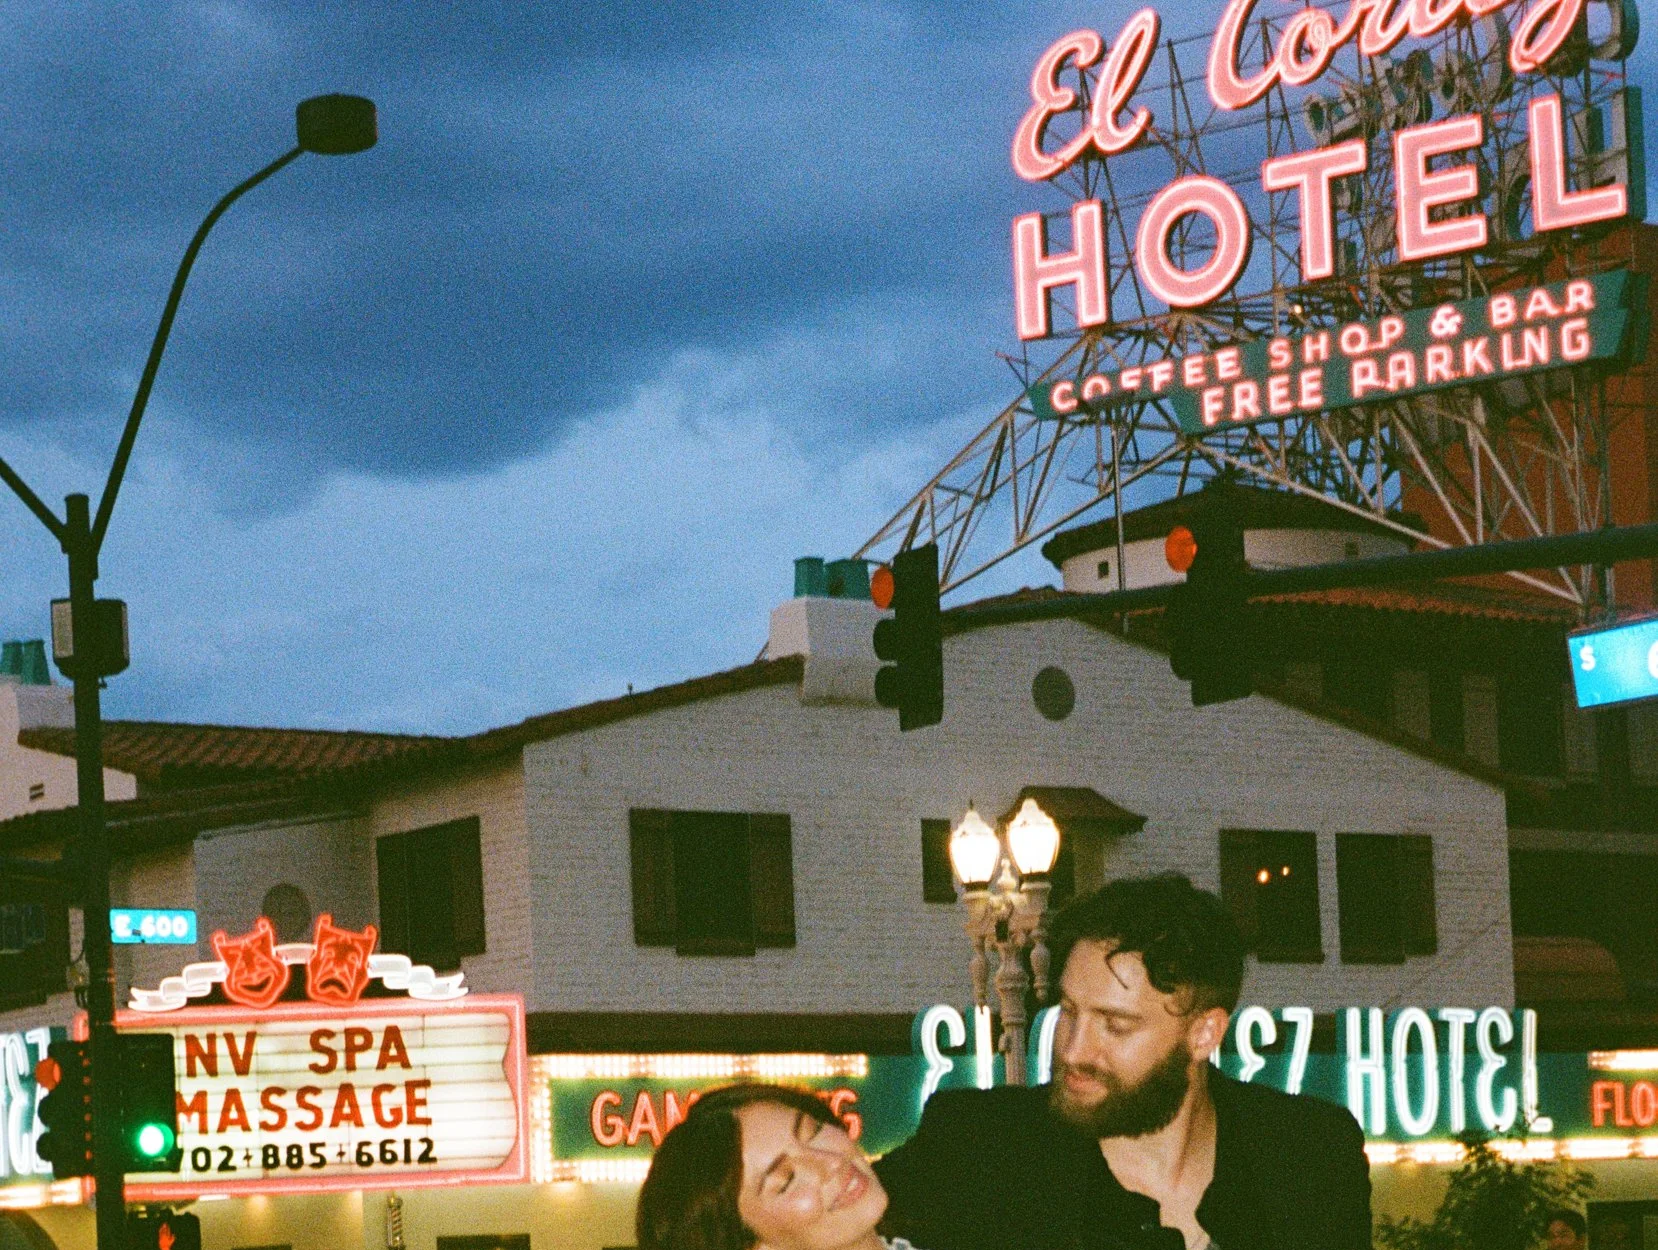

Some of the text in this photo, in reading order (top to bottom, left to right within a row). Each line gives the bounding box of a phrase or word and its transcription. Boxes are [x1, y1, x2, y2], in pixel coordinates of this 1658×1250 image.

[1012, 8, 1161, 181] El
[1012, 94, 1627, 341] HOTEL
[1267, 315, 1404, 370] SHOP
[1430, 304, 1463, 338] &
[1488, 279, 1595, 329] BAR
[1202, 317, 1592, 426] FREE PARKING
[1580, 645, 1596, 671] S
[140, 914, 189, 938] 600
[308, 1025, 412, 1075] SPA
[1346, 1006, 1554, 1136] HOTEL
[175, 1079, 433, 1135] MASSAGE
[1592, 1080, 1658, 1128] FLO
